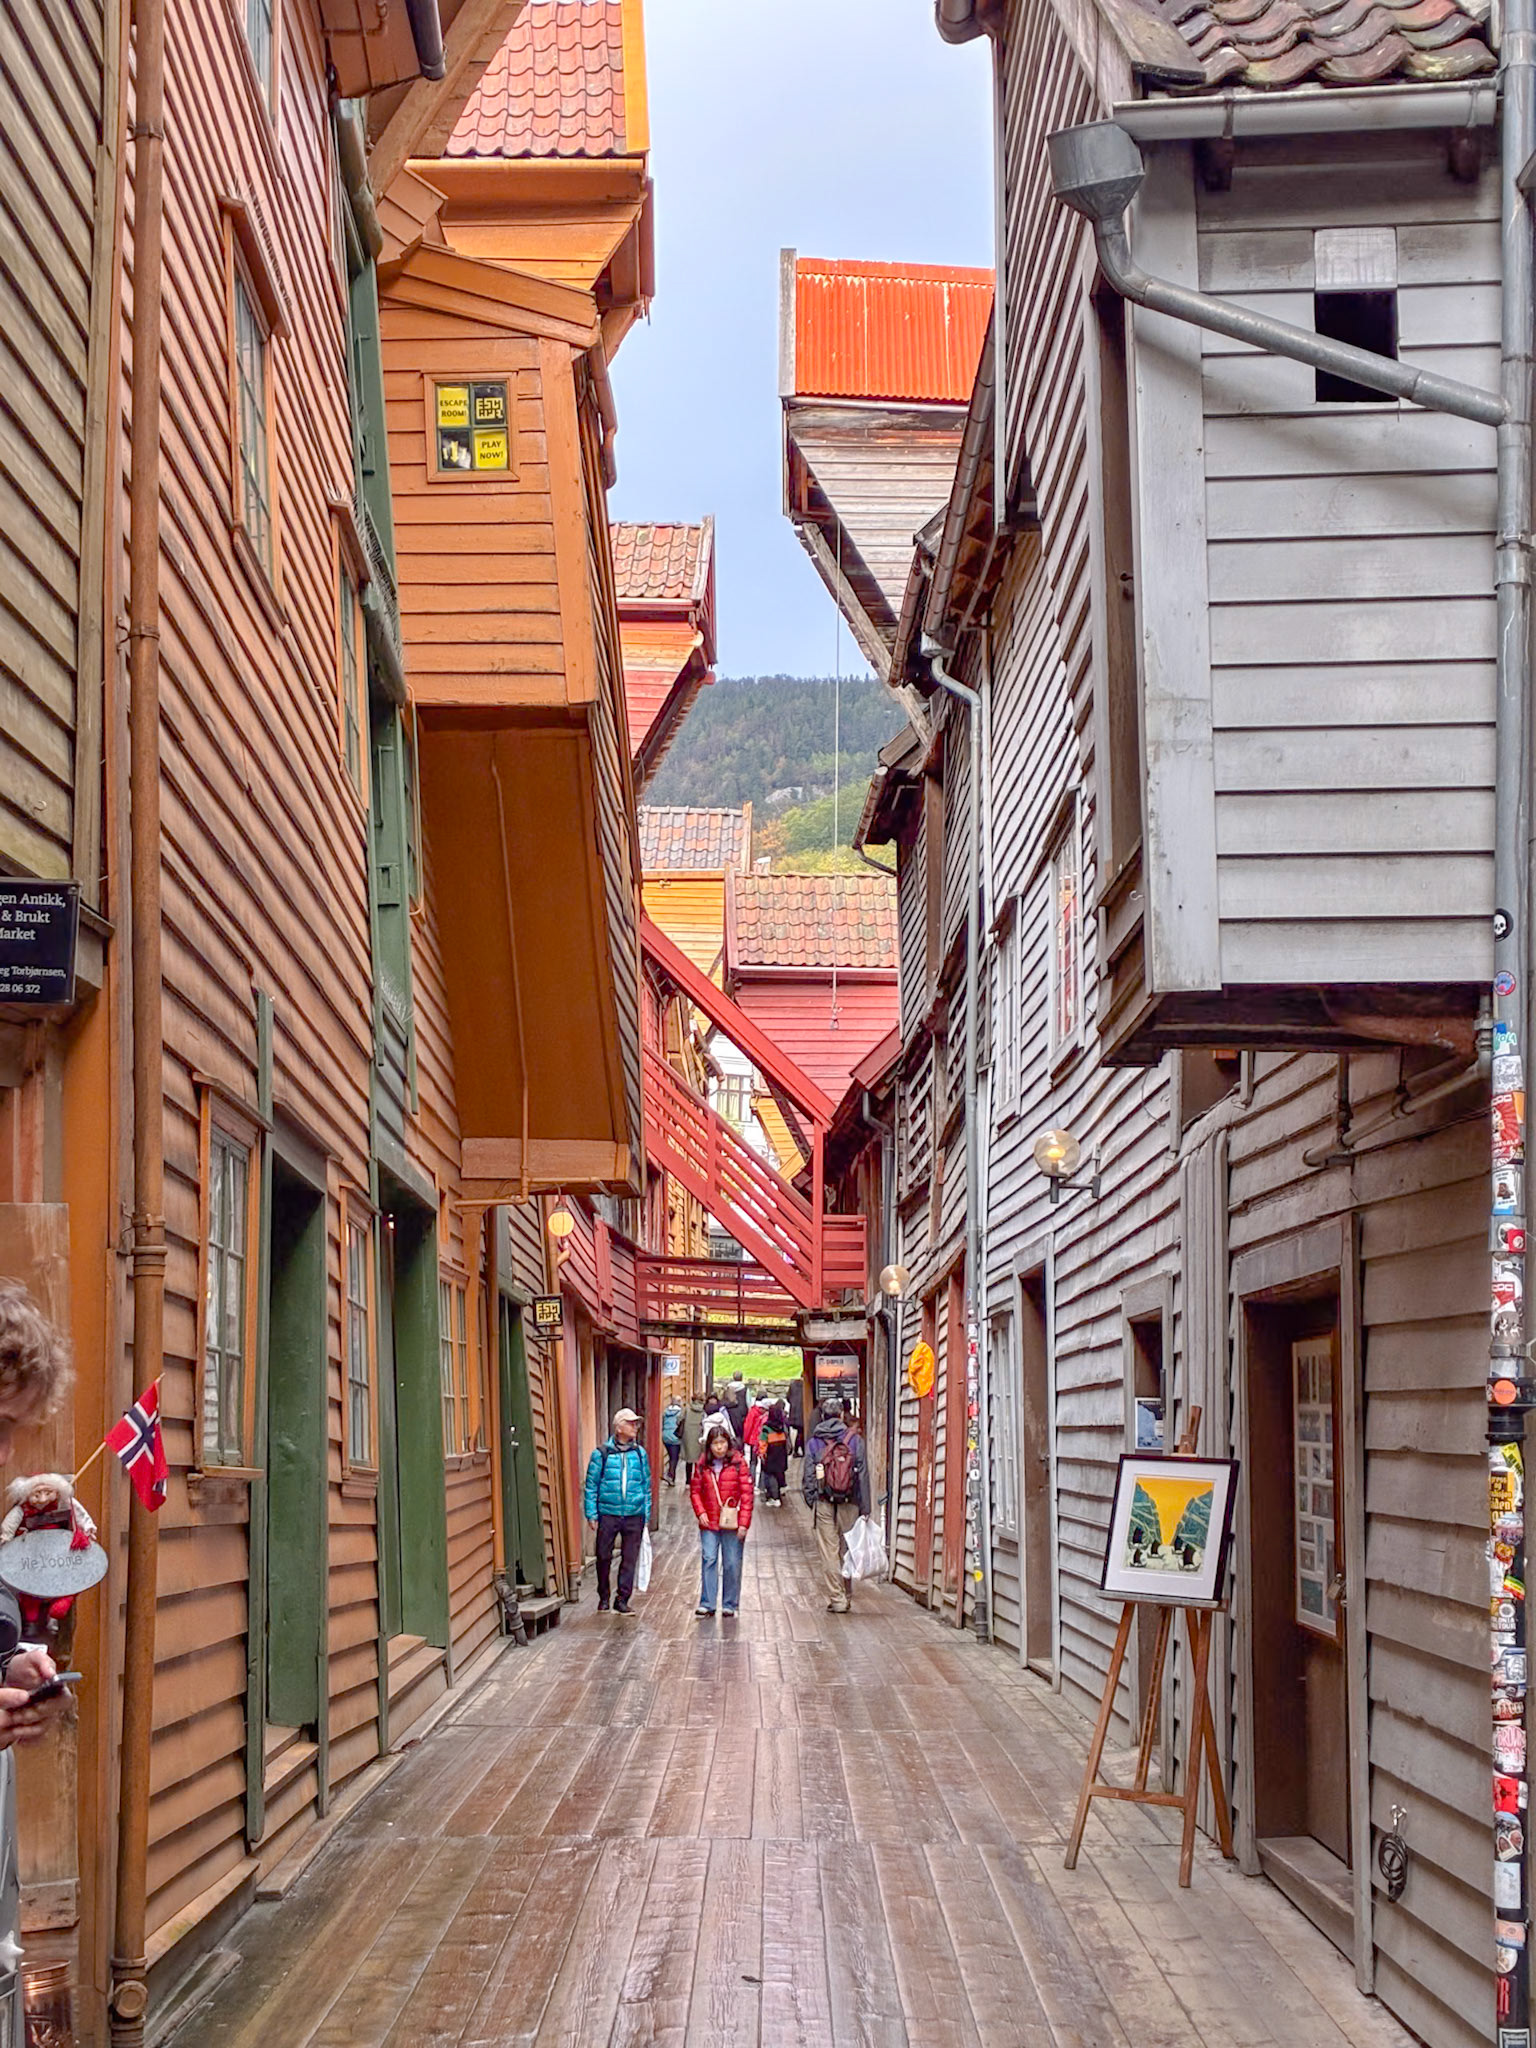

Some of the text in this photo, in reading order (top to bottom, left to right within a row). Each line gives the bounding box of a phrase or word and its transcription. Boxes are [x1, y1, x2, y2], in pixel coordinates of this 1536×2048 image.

[440, 399, 468, 407] ESCAPE
[481, 440, 502, 449] PLAY
[479, 450, 504, 460] NOW!
[19, 893, 66, 908] Antikk,
[1, 909, 51, 923] & Brukt
[11, 983, 24, 993] 06
[24, 984, 41, 994] 372
[20, 1554, 84, 1571] Welcome
